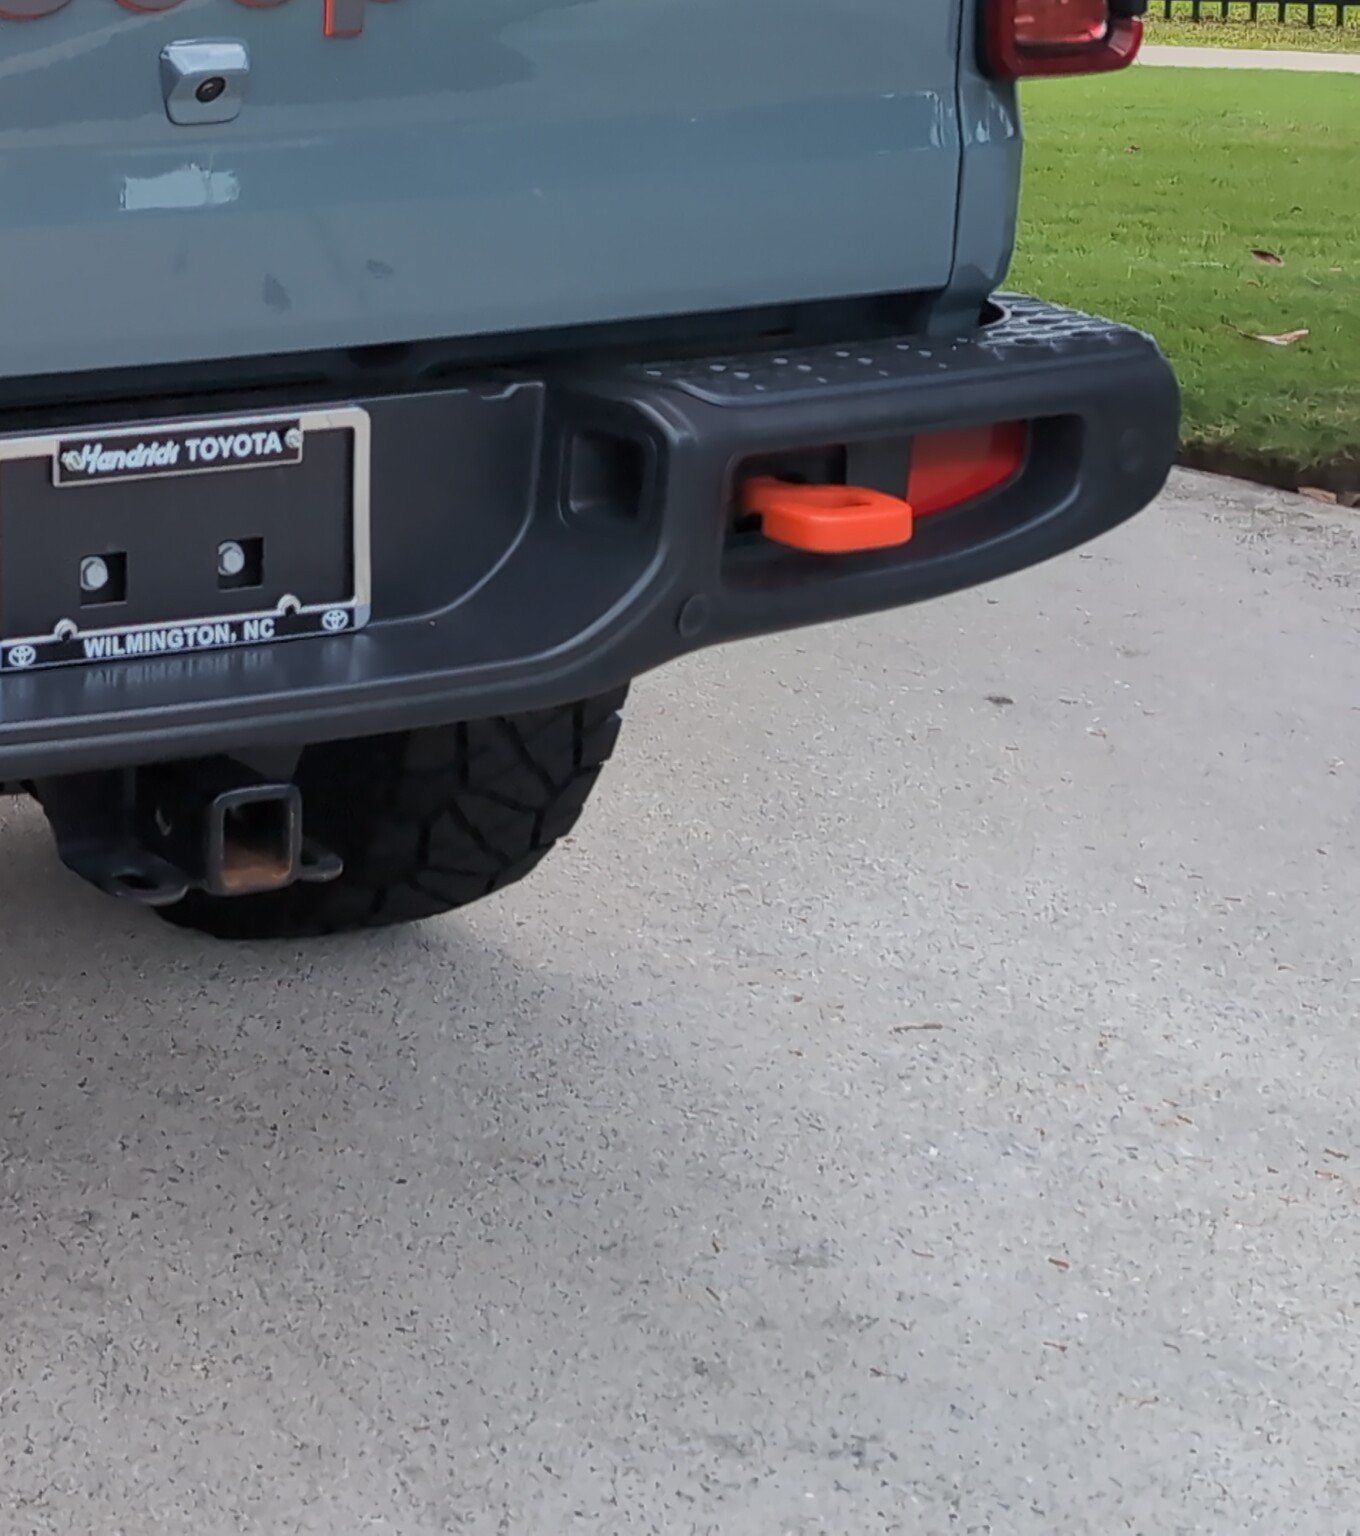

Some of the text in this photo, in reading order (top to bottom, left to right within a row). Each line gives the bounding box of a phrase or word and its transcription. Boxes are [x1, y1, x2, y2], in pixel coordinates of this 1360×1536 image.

[62, 430, 283, 474] Hendrick TOYOTA
[83, 617, 276, 658] WILMINGTON, NC
